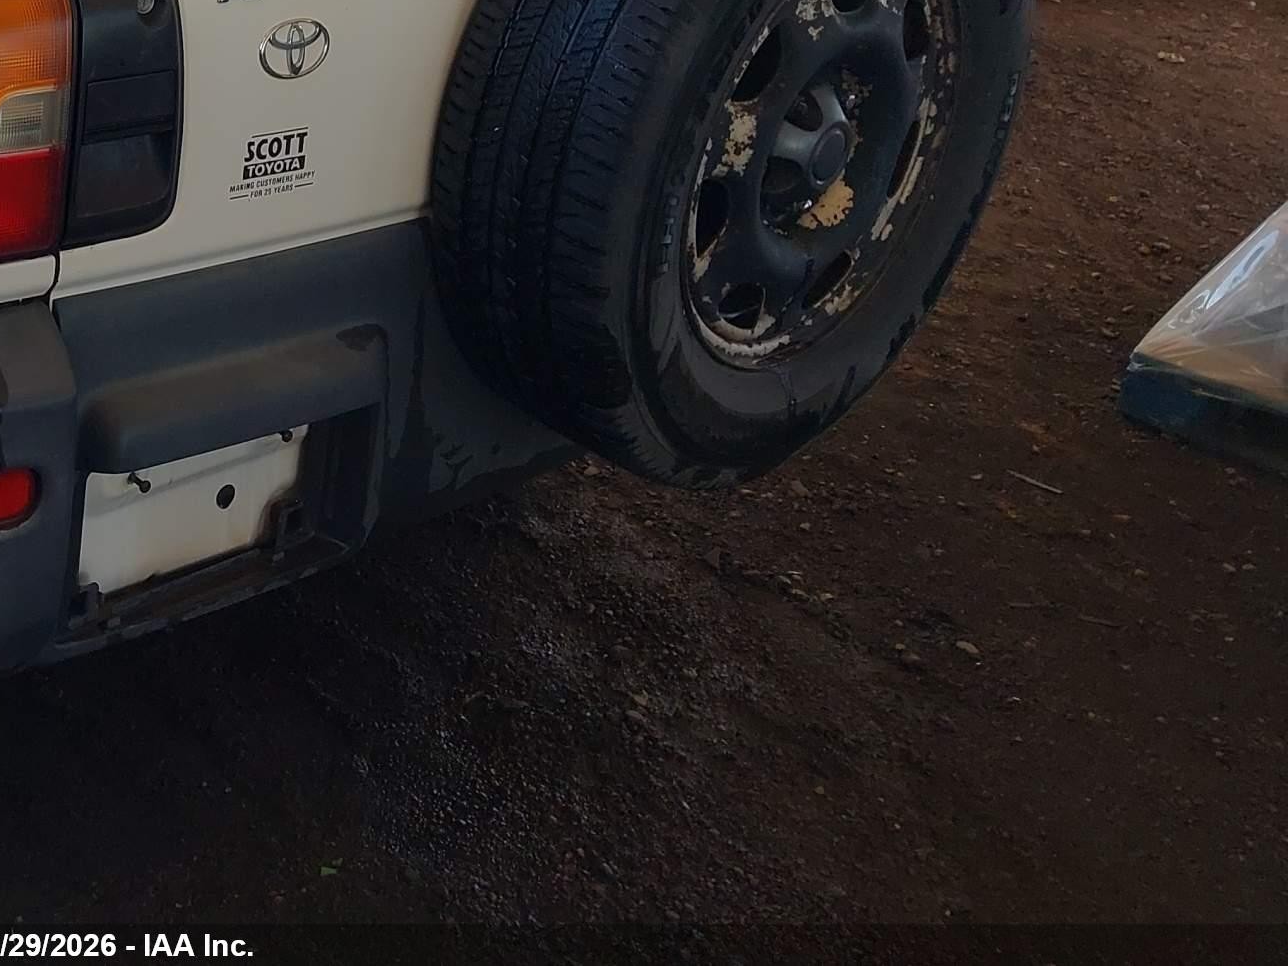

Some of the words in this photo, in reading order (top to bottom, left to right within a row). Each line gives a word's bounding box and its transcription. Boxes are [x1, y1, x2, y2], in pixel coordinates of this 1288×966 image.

[244, 132, 309, 163] SCOTT
[247, 157, 301, 178] TOYOTA
[229, 181, 255, 194] MAKING
[256, 174, 294, 188] CUSTOMERS
[295, 170, 316, 181] HAPPY
[250, 190, 263, 199] FOR
[274, 184, 294, 195] YEARS
